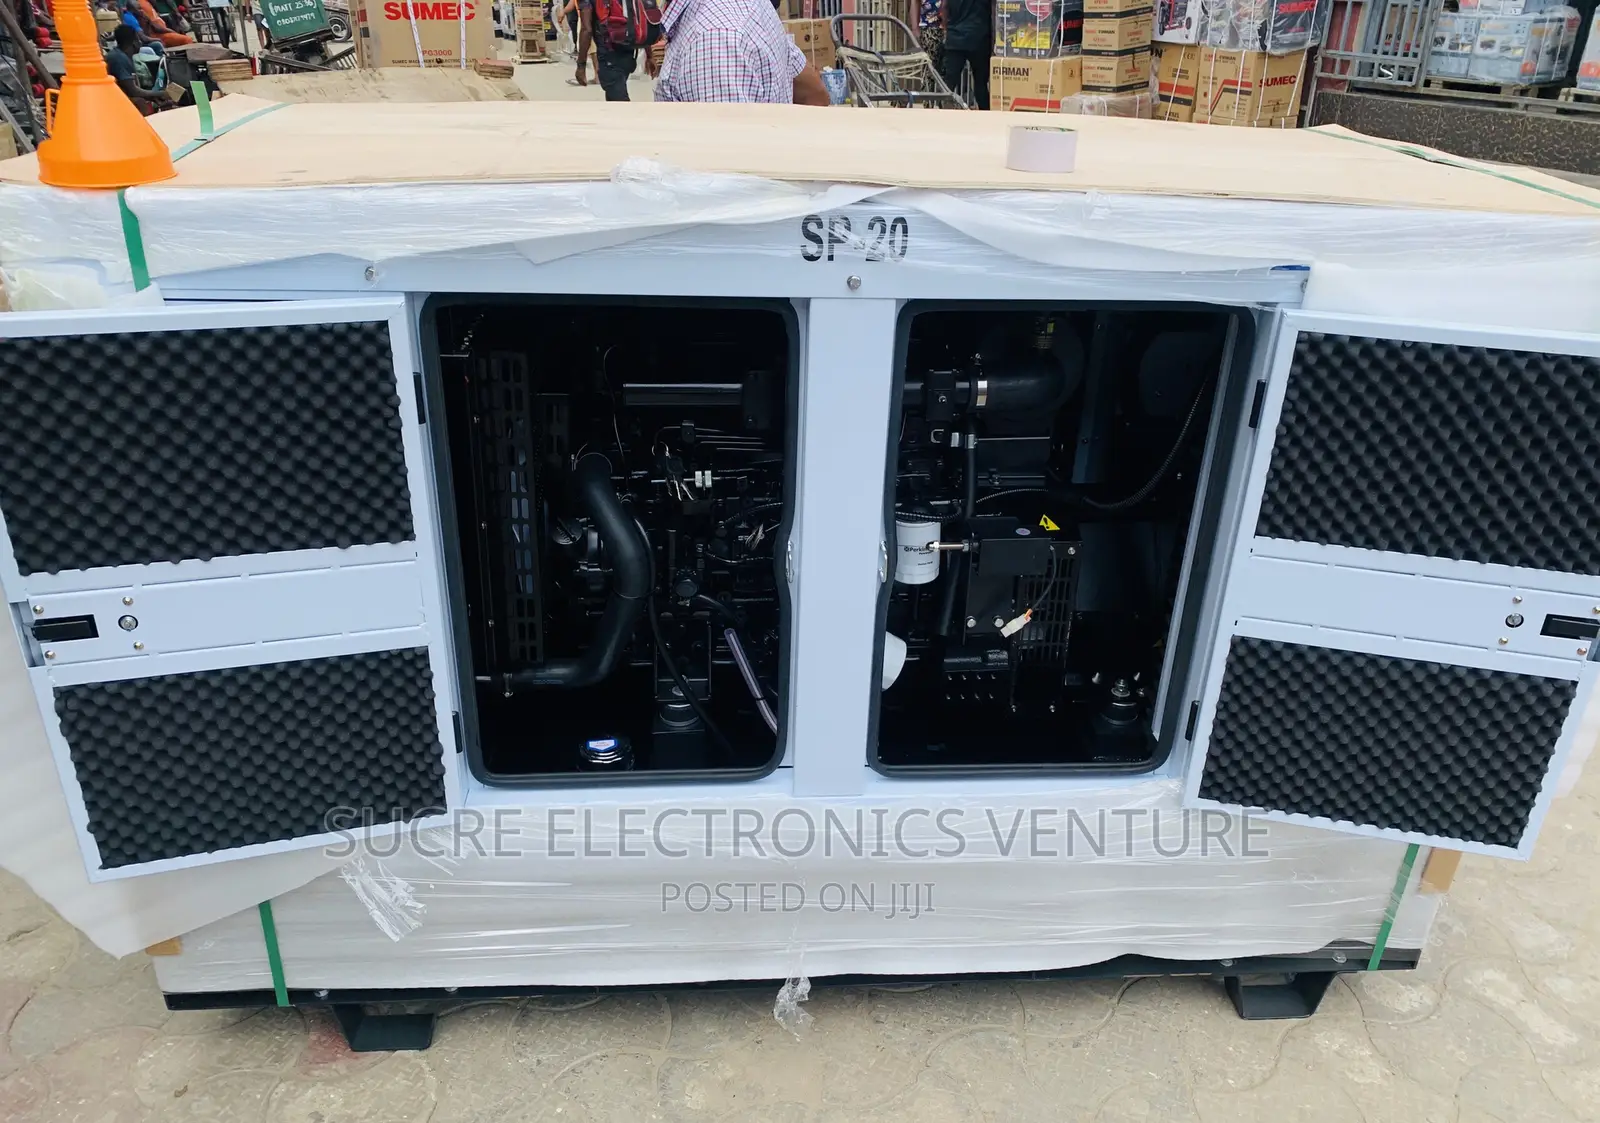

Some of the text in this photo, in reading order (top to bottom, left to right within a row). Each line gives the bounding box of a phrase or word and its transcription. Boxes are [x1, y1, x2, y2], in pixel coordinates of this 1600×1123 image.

[384, 2, 475, 20] SUMEC
[992, 66, 1029, 76] FIRMAN
[1258, 75, 1297, 88] SUMEC
